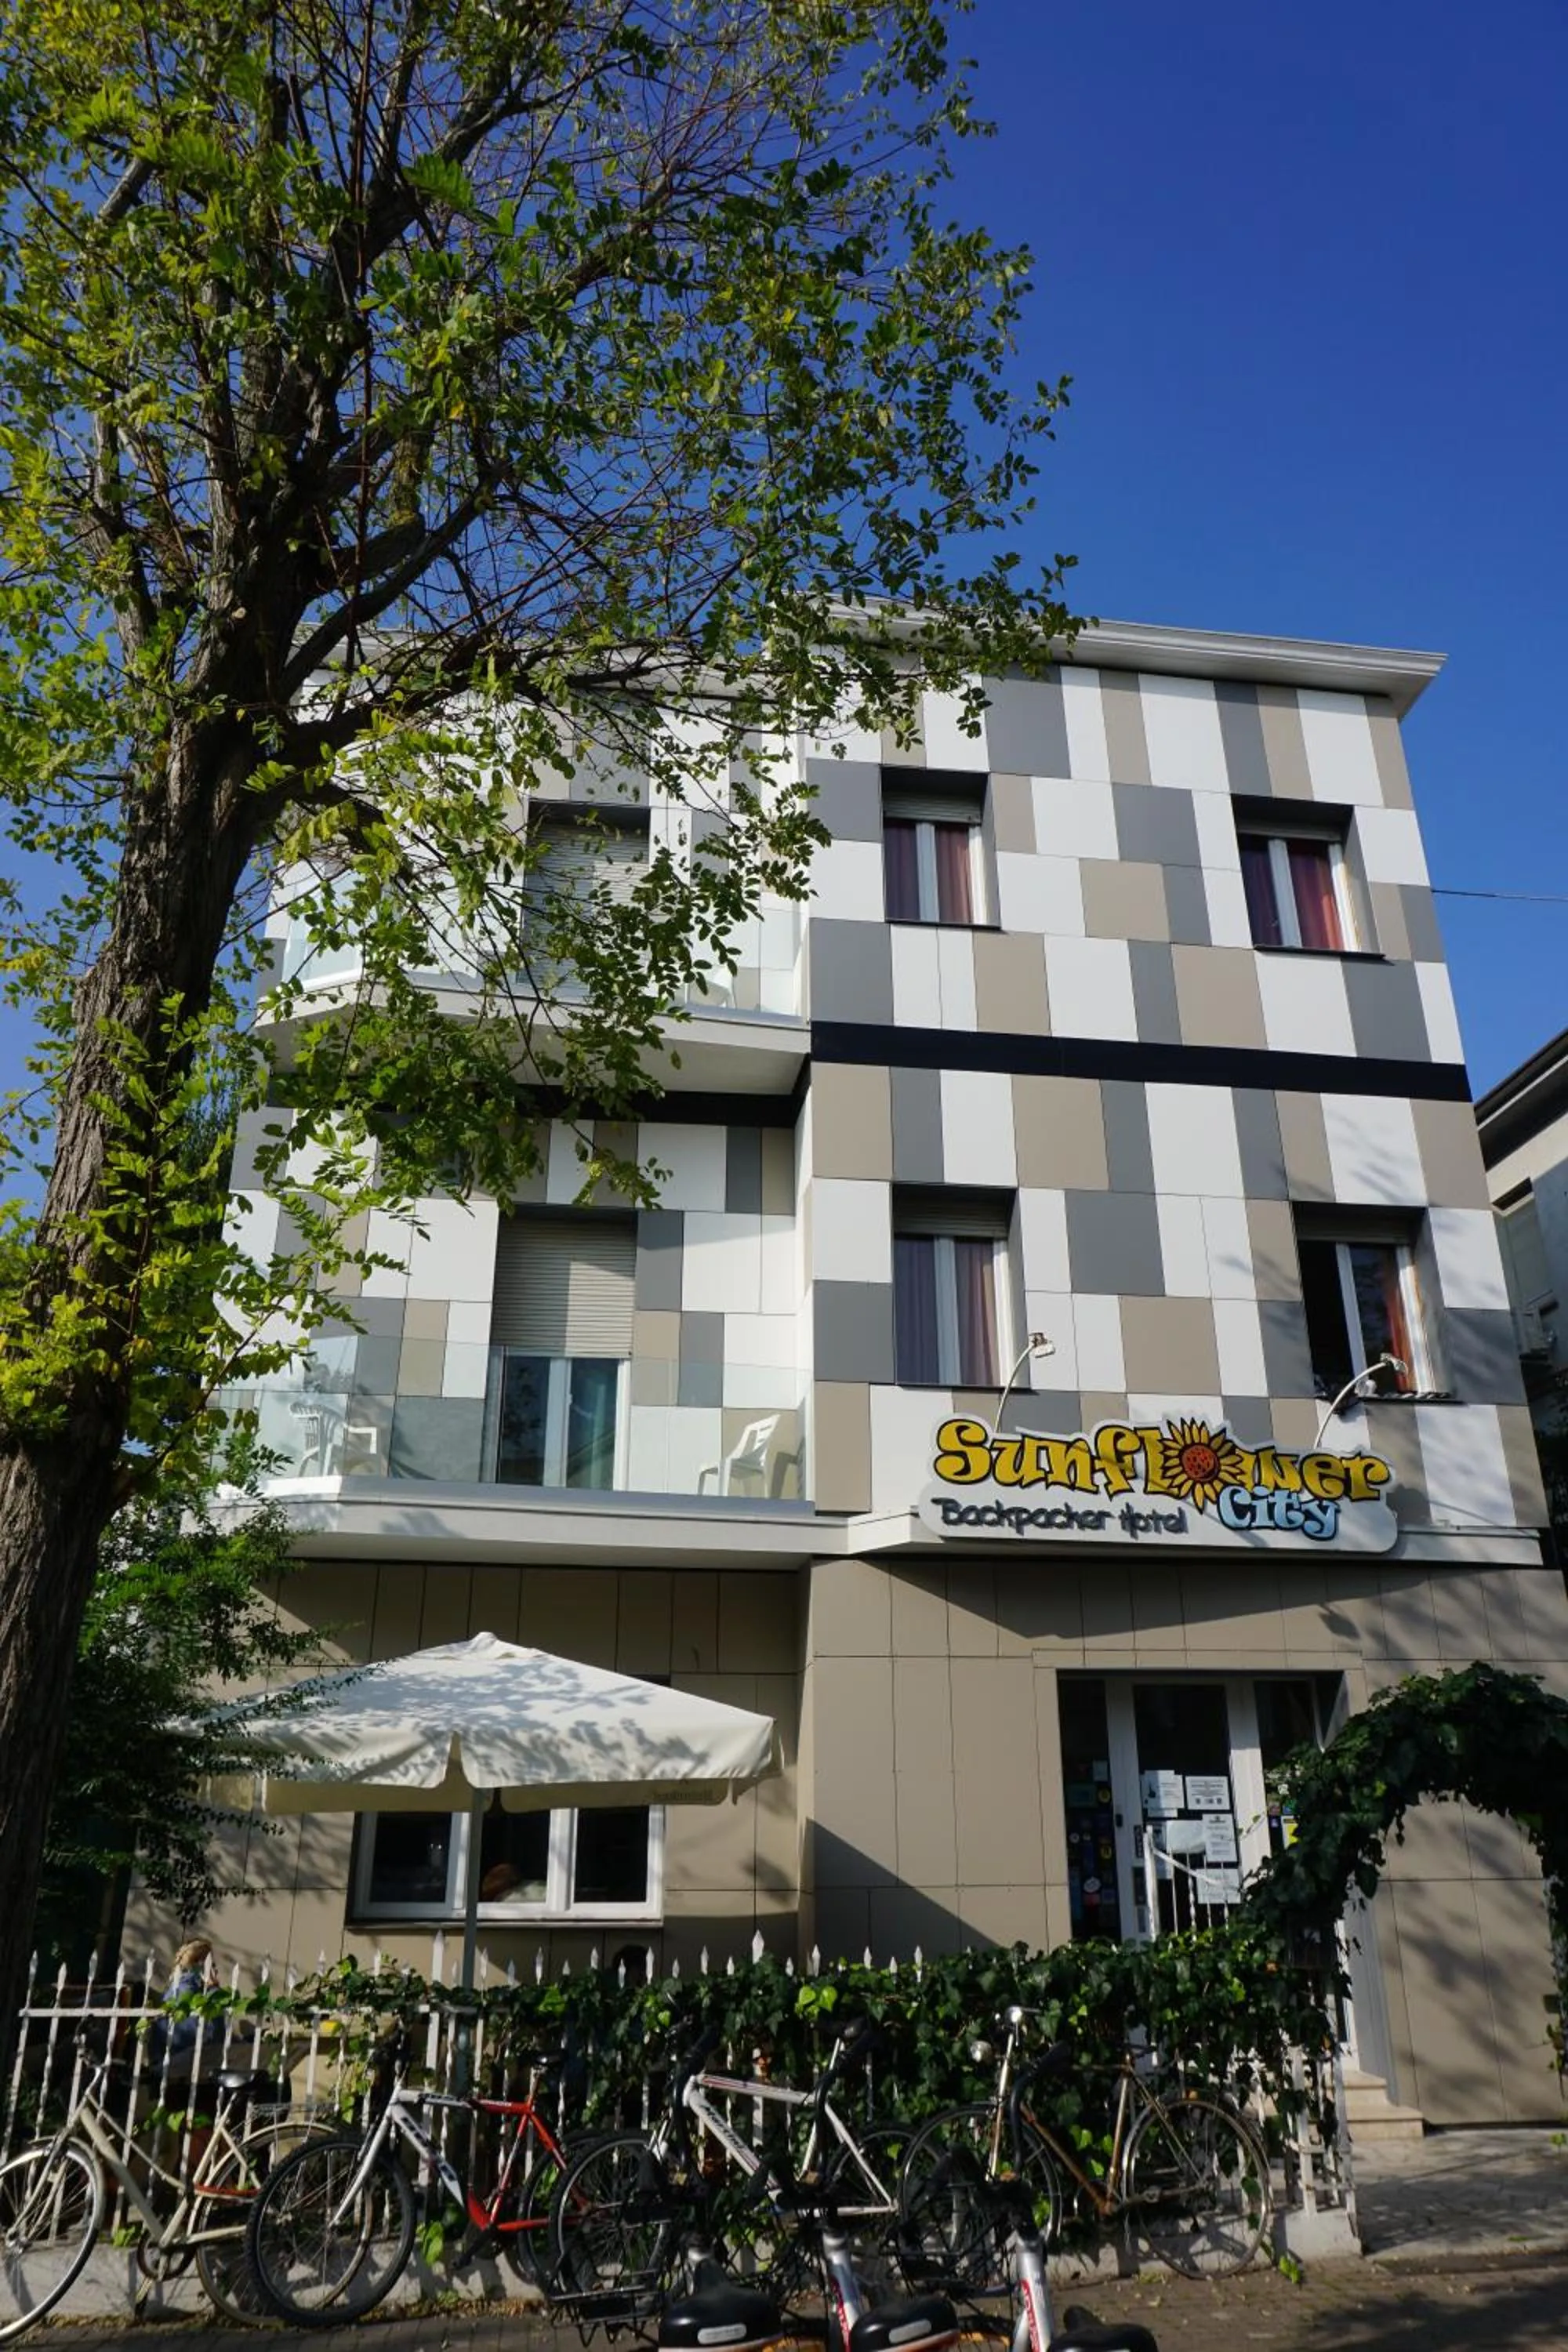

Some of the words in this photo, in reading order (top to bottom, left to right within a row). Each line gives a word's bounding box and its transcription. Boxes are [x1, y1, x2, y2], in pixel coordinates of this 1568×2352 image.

[931, 1497, 1116, 1537] Backpacker
[1118, 1501, 1189, 1541] Hotel
[1217, 1483, 1341, 1541] City
